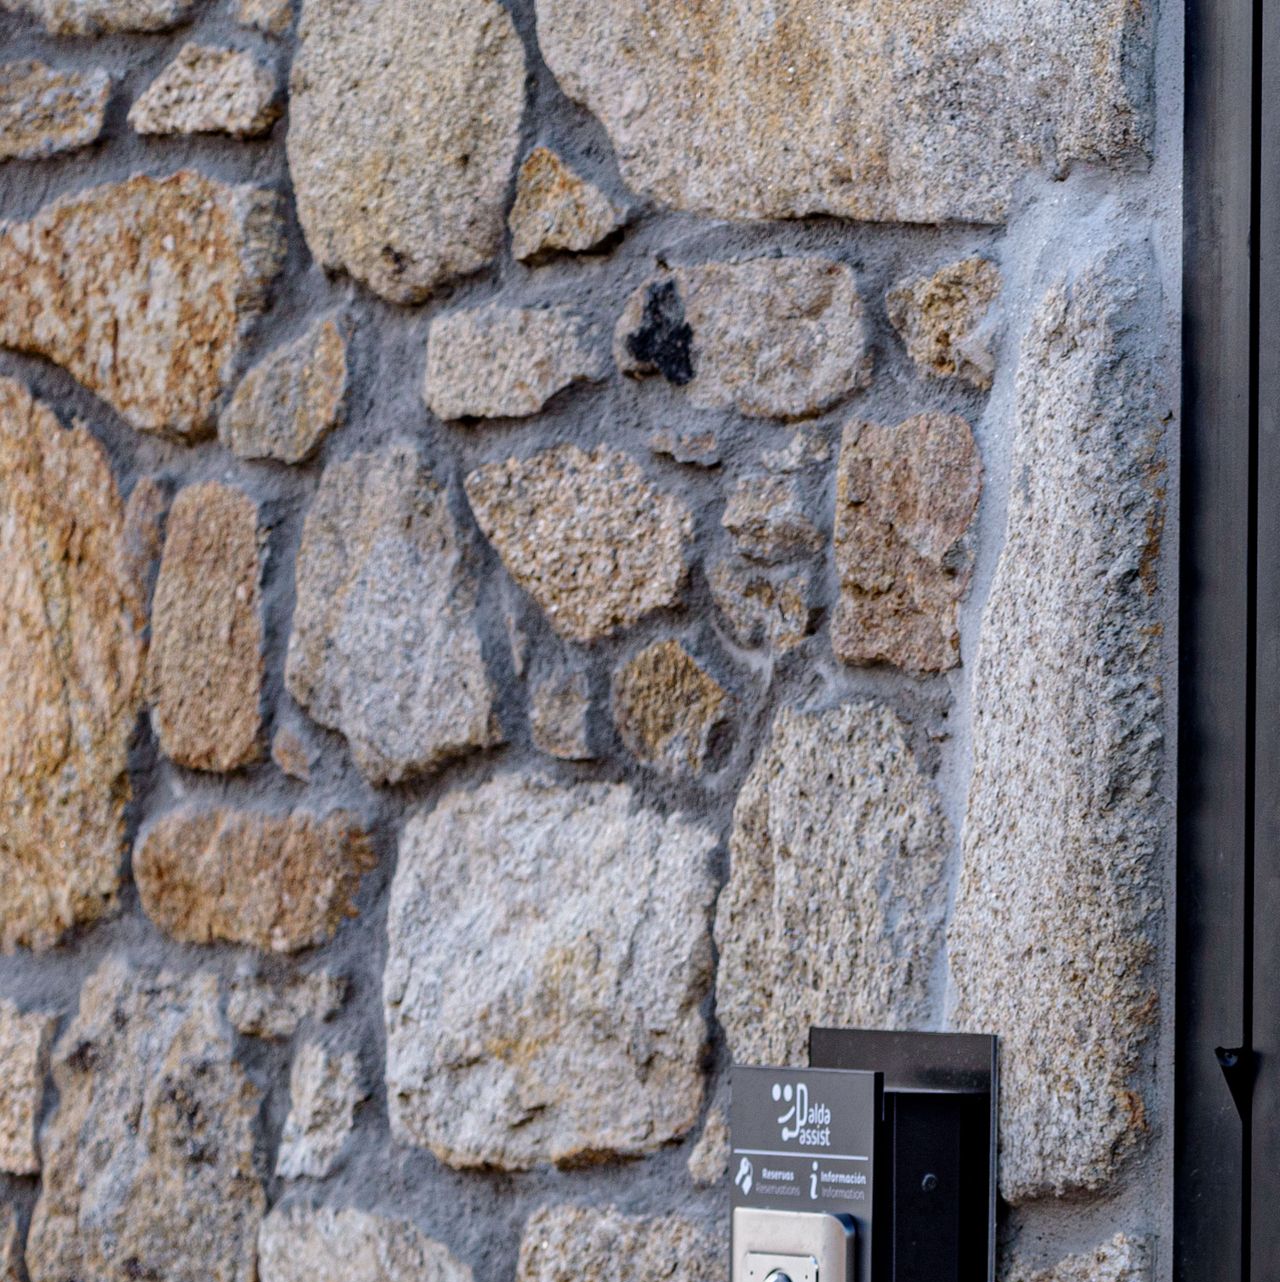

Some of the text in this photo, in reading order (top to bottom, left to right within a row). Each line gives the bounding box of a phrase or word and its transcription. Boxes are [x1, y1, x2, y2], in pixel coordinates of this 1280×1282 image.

[799, 1125, 831, 1146] assist
[762, 1168, 795, 1181] Reservas
[821, 1171, 866, 1185] Información
